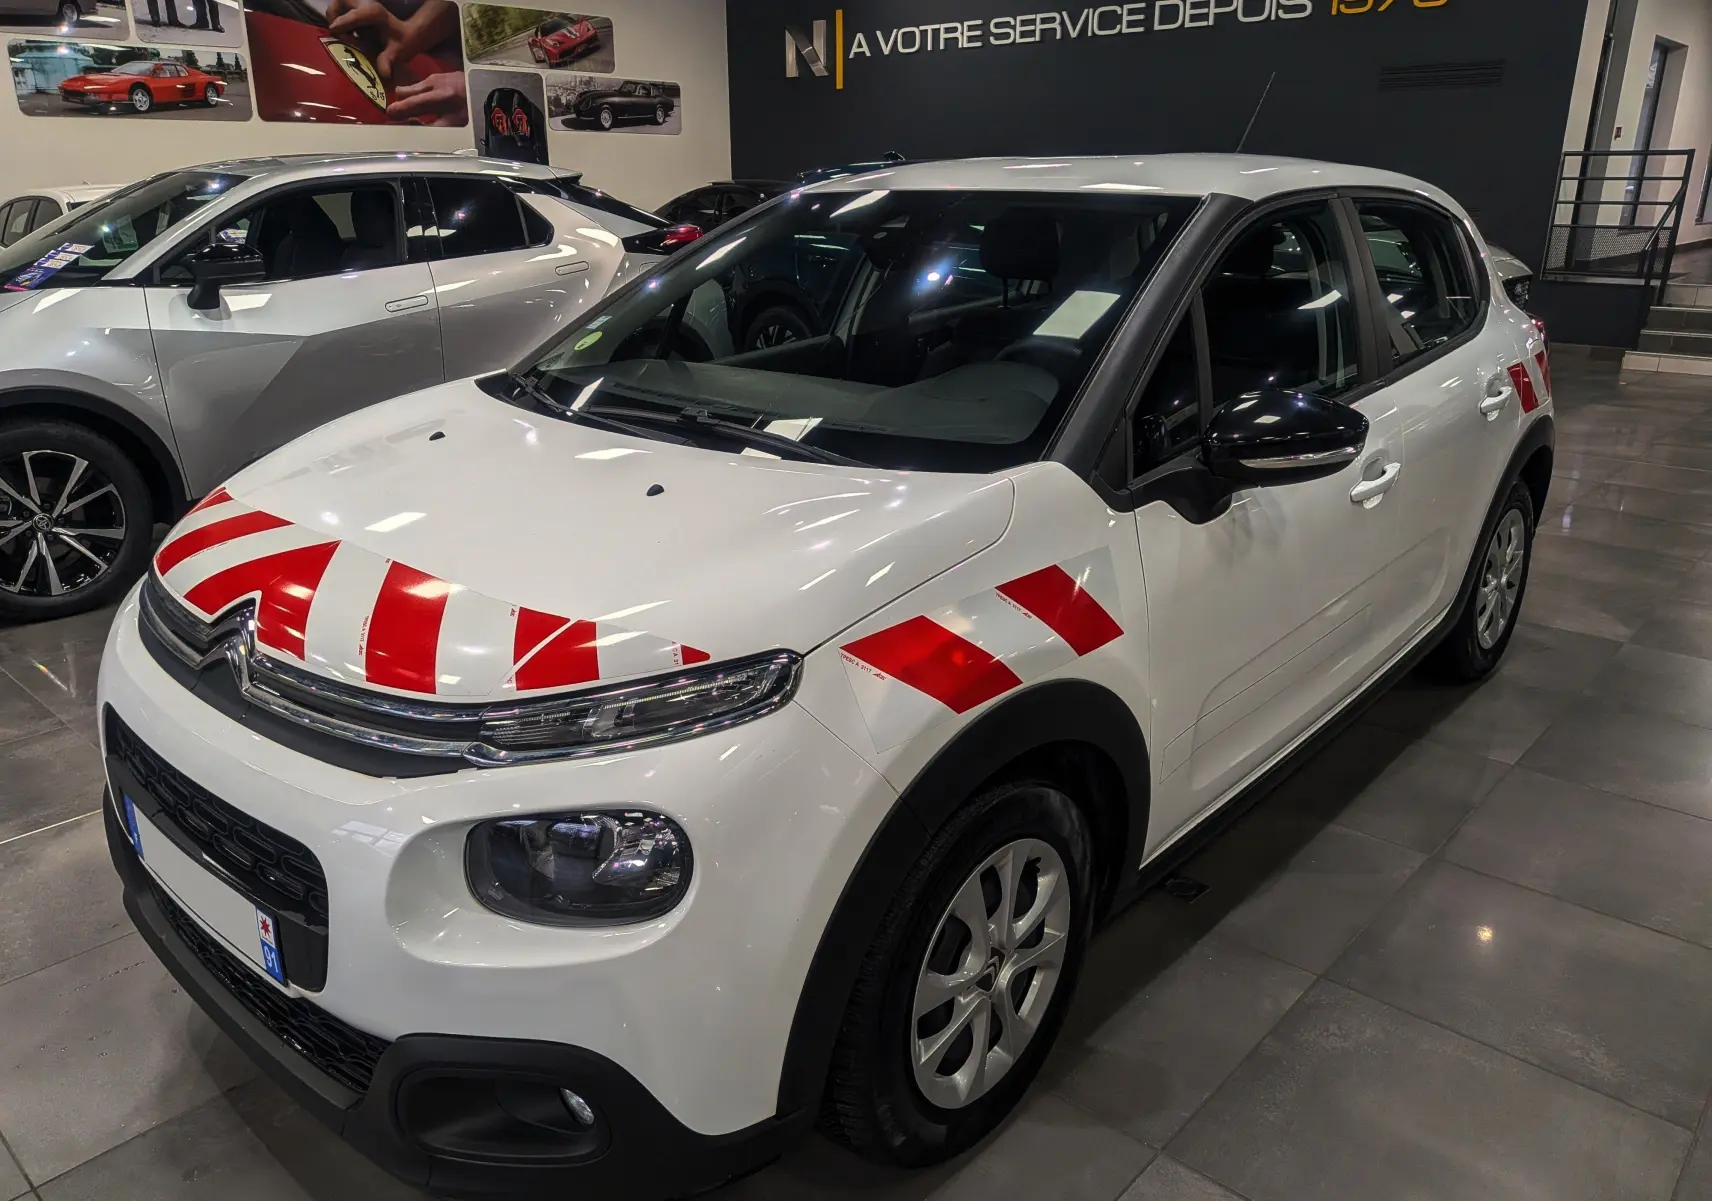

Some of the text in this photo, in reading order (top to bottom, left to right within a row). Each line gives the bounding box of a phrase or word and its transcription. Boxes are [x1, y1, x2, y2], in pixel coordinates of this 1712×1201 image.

[848, 32, 872, 59] A
[876, 19, 984, 56] VOTRE
[989, 2, 1146, 46] SERVICE
[1153, 0, 1313, 31] DEPUIS
[264, 945, 279, 973] 91
